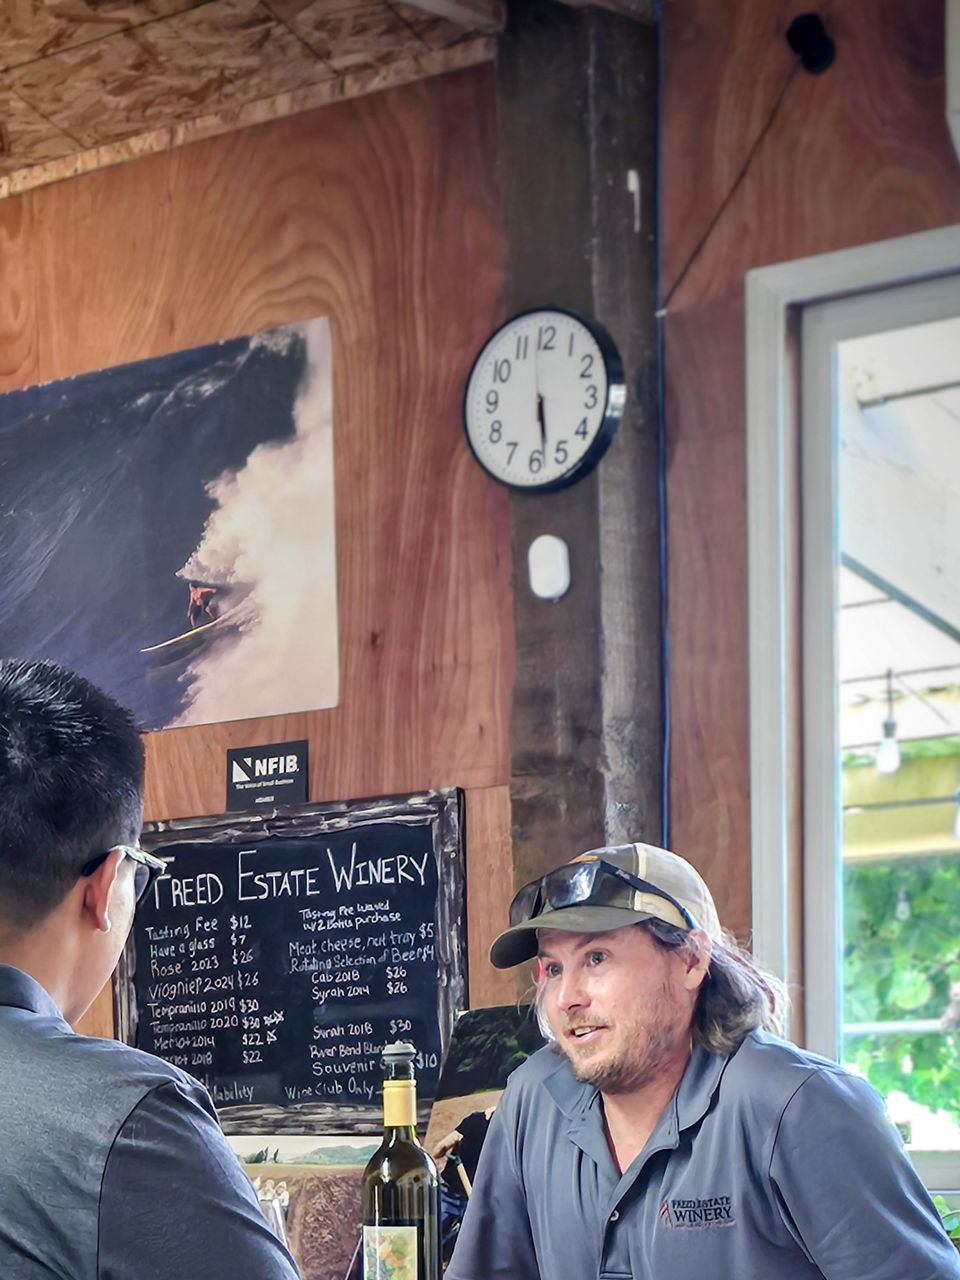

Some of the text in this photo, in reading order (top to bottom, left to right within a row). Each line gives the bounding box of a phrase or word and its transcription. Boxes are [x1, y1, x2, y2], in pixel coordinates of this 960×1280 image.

[516, 336, 529, 360] 11
[538, 326, 556, 351] 12
[568, 332, 574, 357] 1
[493, 359, 511, 383] 10
[580, 354, 594, 378] 2
[486, 390, 499, 414] 9
[584, 385, 598, 409] 3
[489, 420, 502, 443] 8
[574, 417, 588, 440] 4
[506, 442, 518, 466] 7
[528, 450, 542, 473] 6
[554, 440, 568, 464] 5
[238, 849, 320, 901] ESTATE
[327, 842, 428, 894] WINERY
[145, 914, 252, 940] Tasting Fee $12
[390, 930, 416, 947] tray
[419, 922, 434, 939] $5
[150, 933, 246, 958] Have a glass $7
[191, 955, 220, 972] 2023
[232, 948, 254, 965] $26
[203, 973, 234, 993] 2024
[237, 970, 259, 990] $26
[385, 966, 407, 979] $26
[311, 981, 408, 1005] Syrah 2014 $26
[239, 998, 259, 1013] $30
[210, 1014, 239, 1029] 2020
[241, 1016, 260, 1030] $30
[389, 1019, 412, 1035] $30
[191, 1035, 216, 1048] 2014
[242, 1033, 264, 1046] $22
[191, 1051, 213, 1065] 2018
[242, 1050, 263, 1064] $22
[312, 1059, 375, 1076] Souvenir
[284, 1077, 374, 1100] Wine Club Only
[674, 1207, 732, 1223] WINERY
